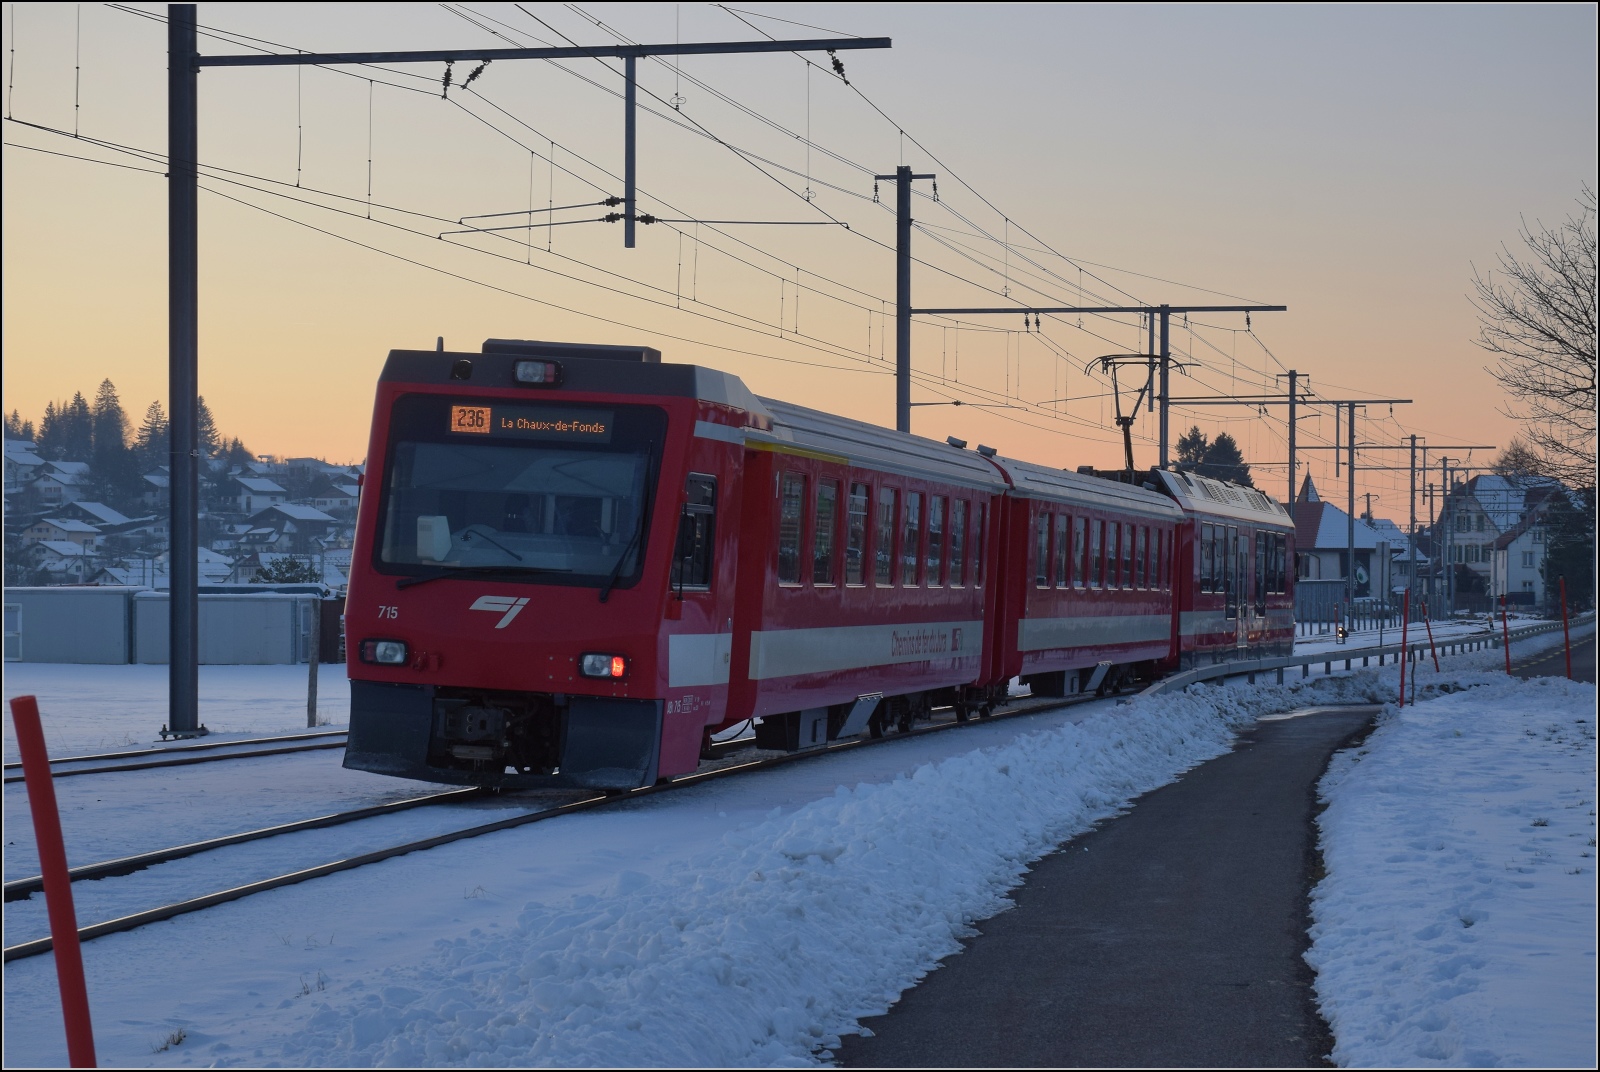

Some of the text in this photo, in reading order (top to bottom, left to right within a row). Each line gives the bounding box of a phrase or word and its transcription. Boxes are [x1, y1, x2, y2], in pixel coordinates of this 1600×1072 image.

[457, 408, 485, 428] 236
[501, 417, 605, 433] La Chaux-de-Fonds
[378, 605, 398, 619] 715
[892, 630, 915, 657] Chemins
